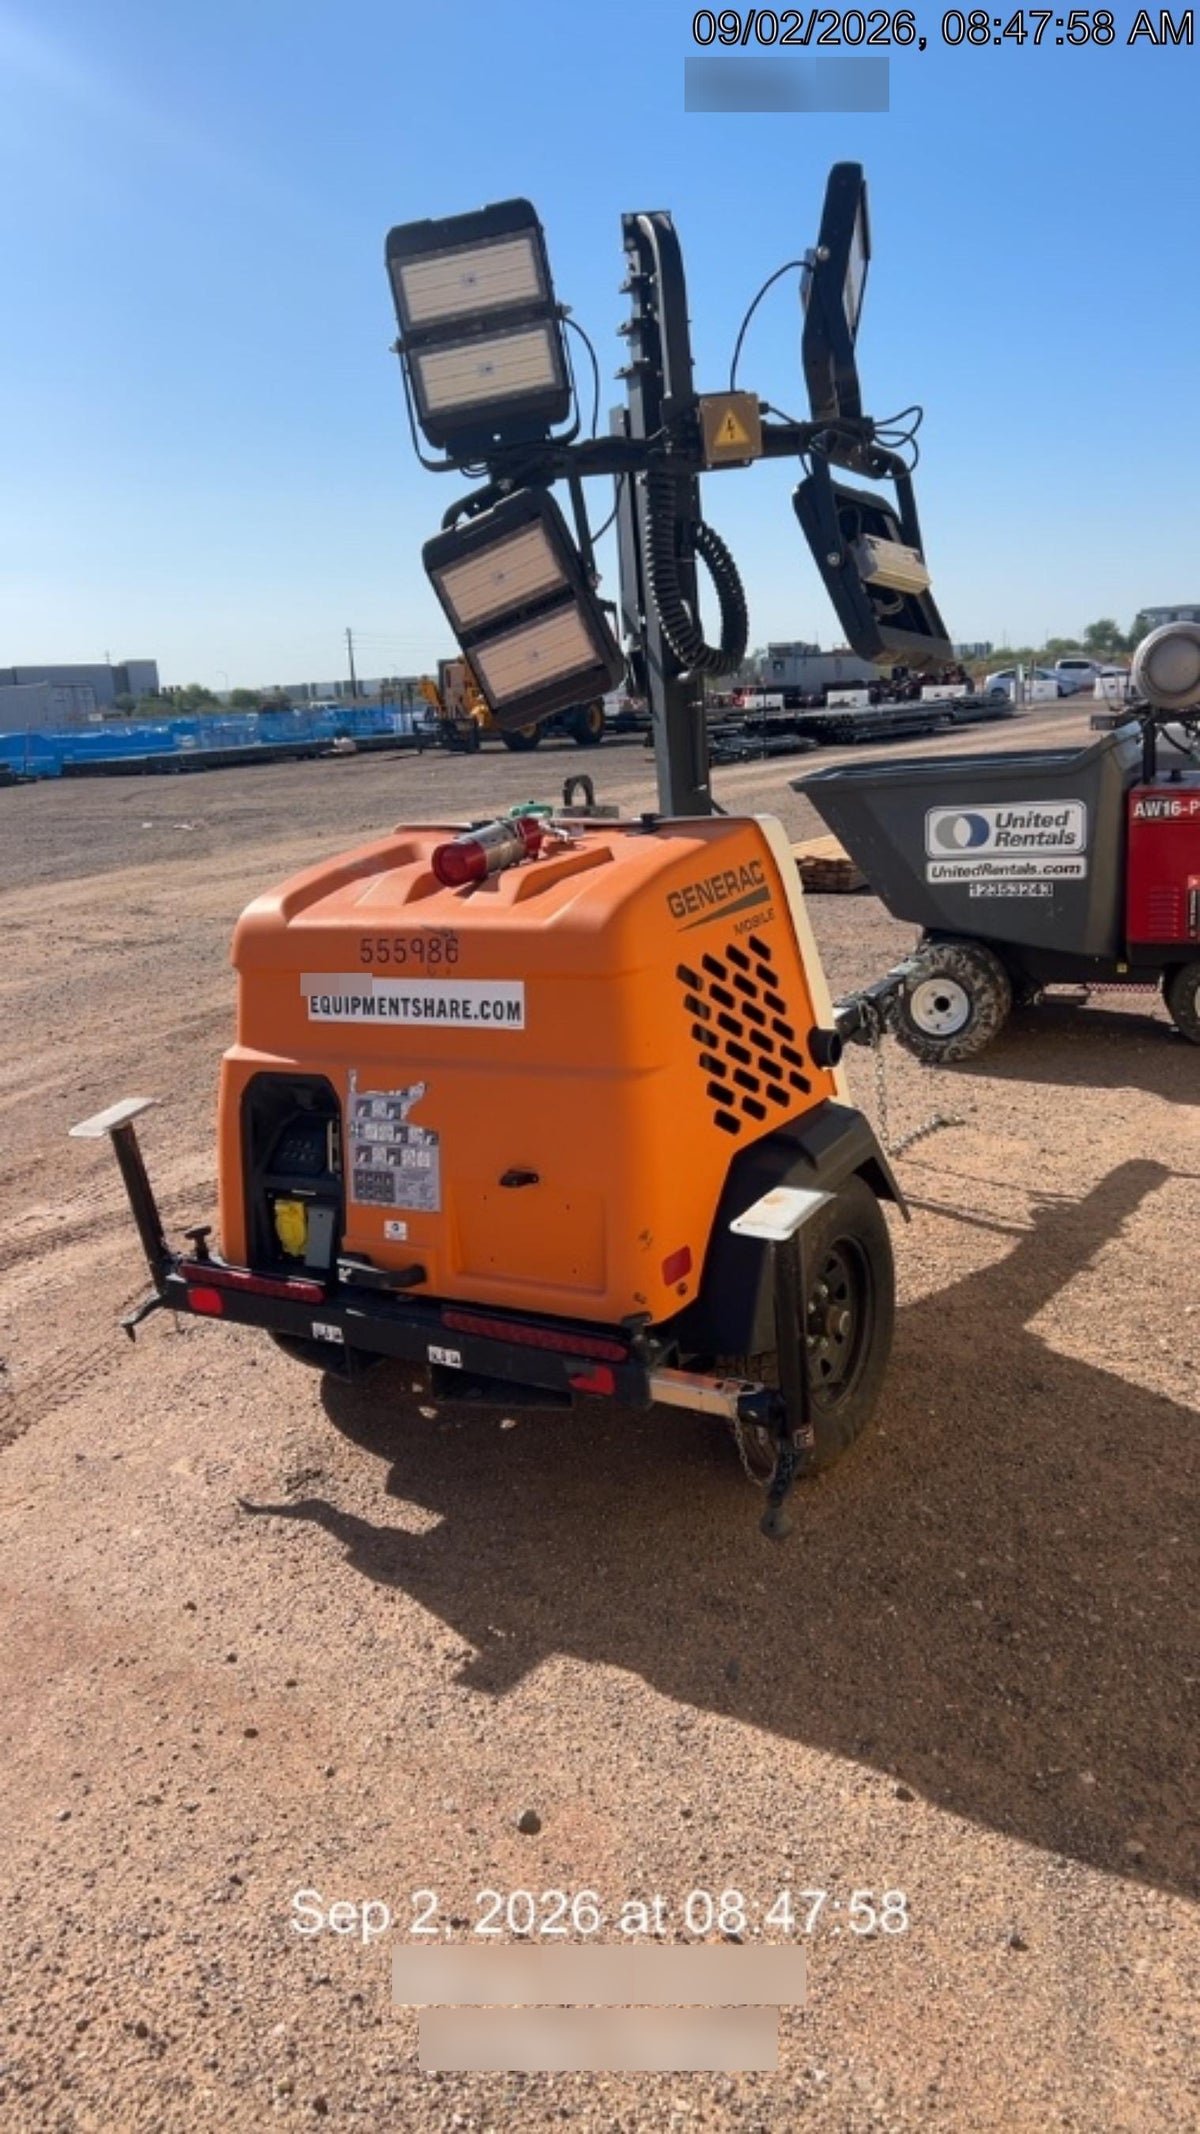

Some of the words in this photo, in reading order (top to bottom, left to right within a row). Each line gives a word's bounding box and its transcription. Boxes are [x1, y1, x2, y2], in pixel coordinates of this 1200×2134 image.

[995, 811, 1070, 829] United
[994, 830, 1076, 847] Rentals
[931, 862, 1081, 878] UnitedRentals.com
[667, 860, 765, 918] GENERAC
[734, 908, 775, 936] MOBILE
[360, 938, 459, 964] 555986
[310, 996, 522, 1021] EQUIPMENTSHARE.COM
